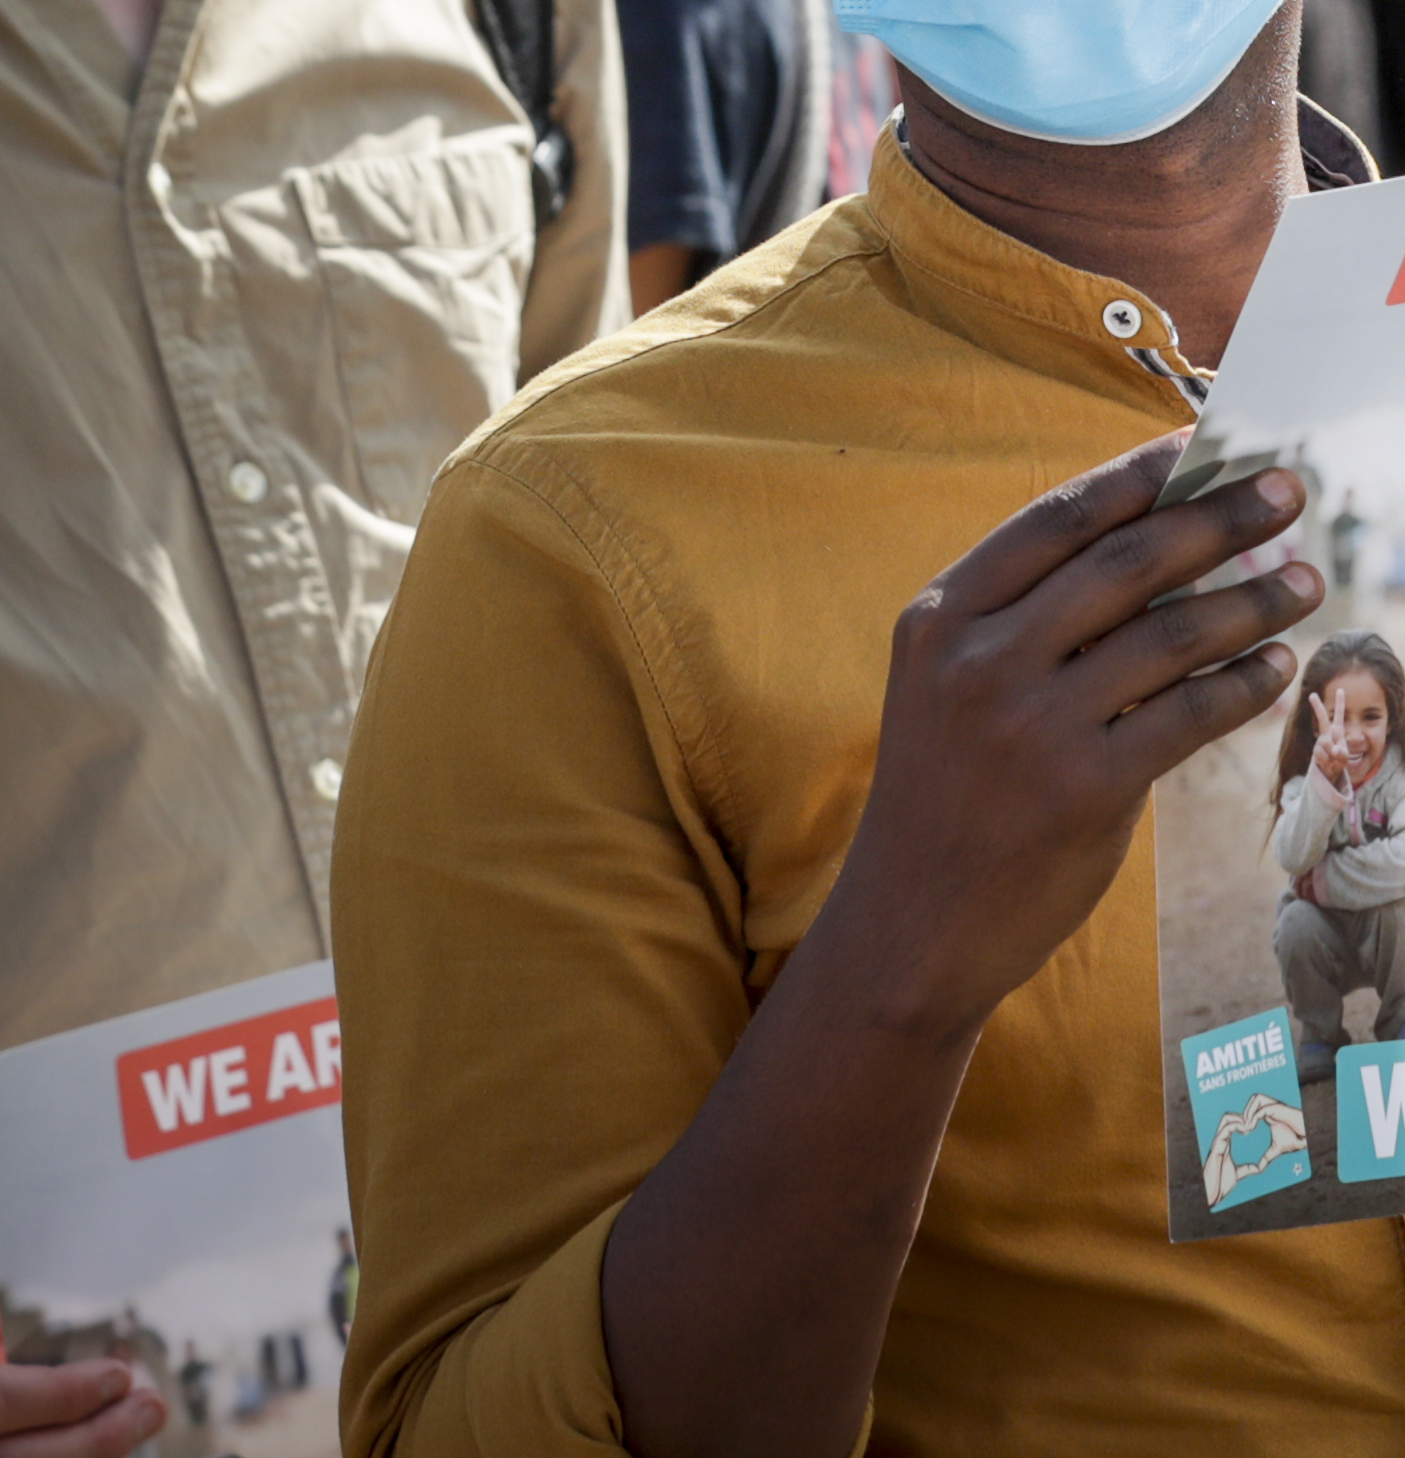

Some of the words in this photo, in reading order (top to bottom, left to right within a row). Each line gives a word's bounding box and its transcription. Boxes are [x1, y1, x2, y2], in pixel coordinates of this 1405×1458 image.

[141, 1045, 253, 1134] WE
[265, 1018, 342, 1103] AR
[1196, 1020, 1285, 1079] AMITIÉ
[1198, 1073, 1226, 1094] SANS
[1227, 1053, 1287, 1085] FRONTIÈRES
